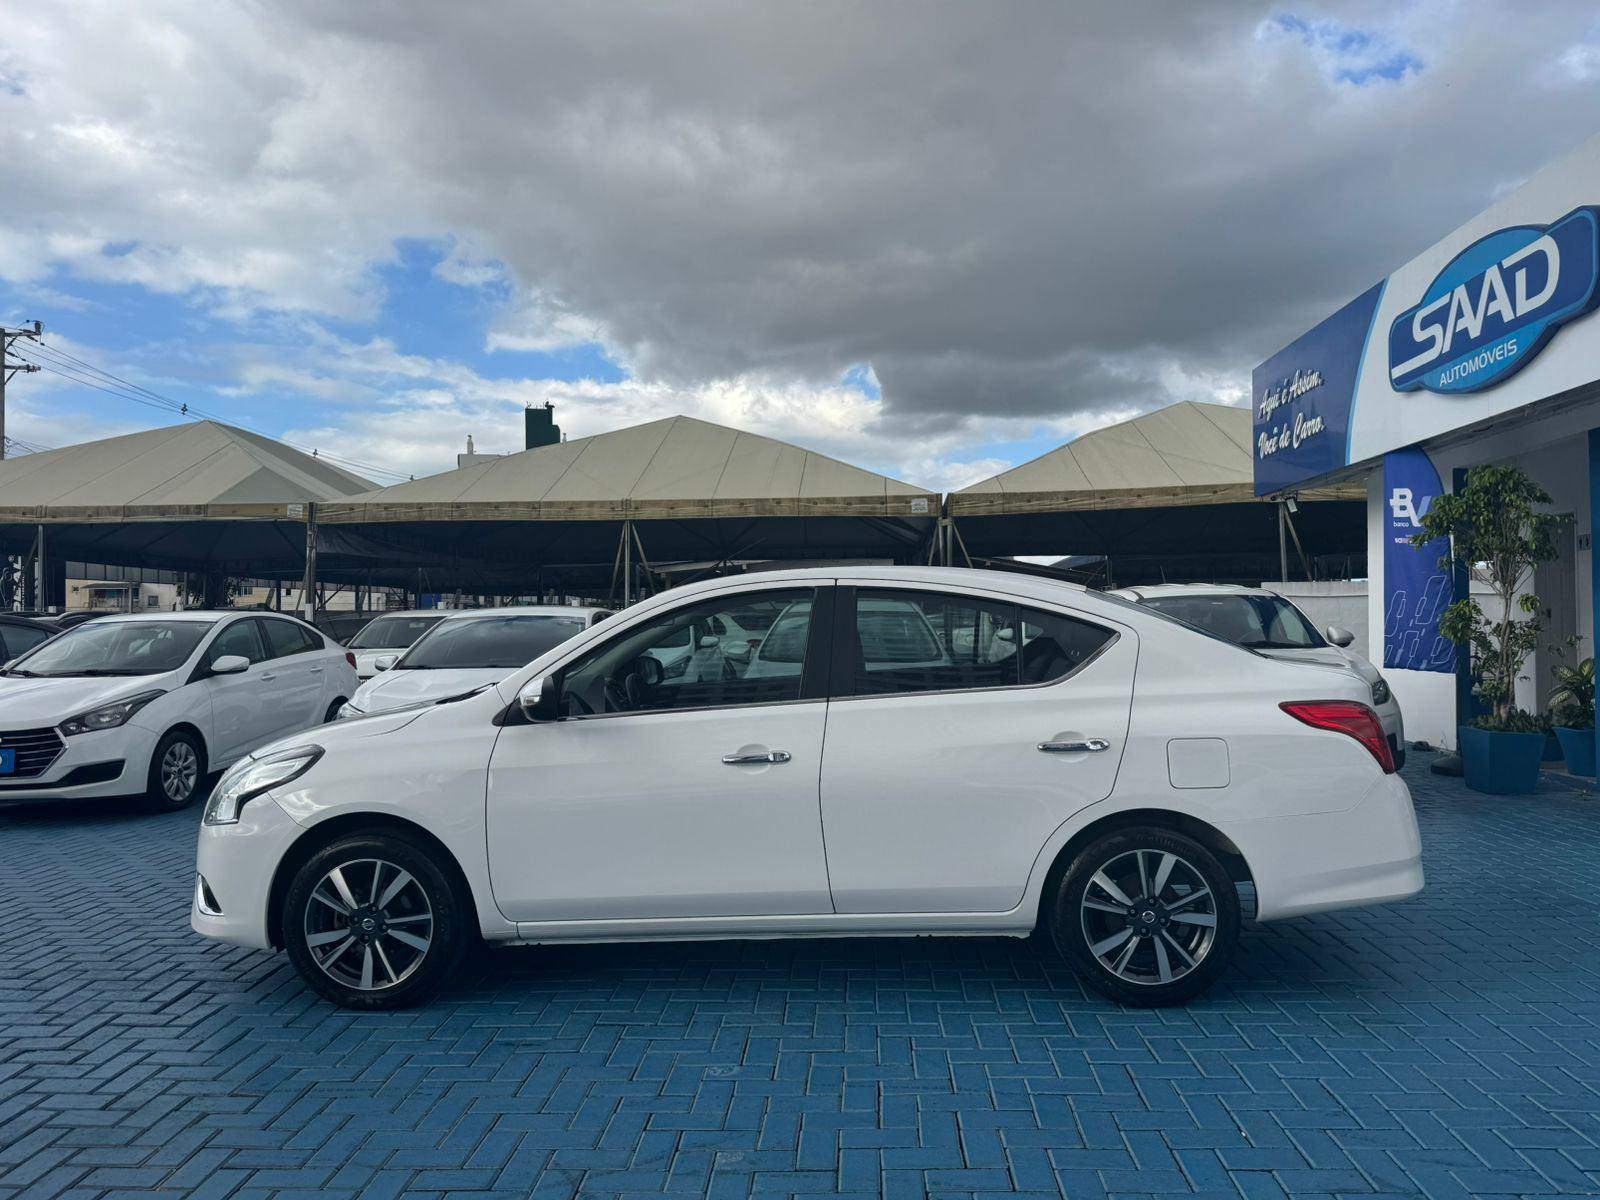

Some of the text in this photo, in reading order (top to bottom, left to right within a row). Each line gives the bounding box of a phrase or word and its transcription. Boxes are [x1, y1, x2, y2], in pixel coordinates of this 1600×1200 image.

[1392, 234, 1560, 379] SAAD
[1439, 338, 1517, 387] AUTOMÓVEIS
[1258, 388, 1280, 421] Aqui
[1258, 426, 1279, 459] Você
[1279, 423, 1291, 449] de
[1390, 488, 1431, 527] BV
